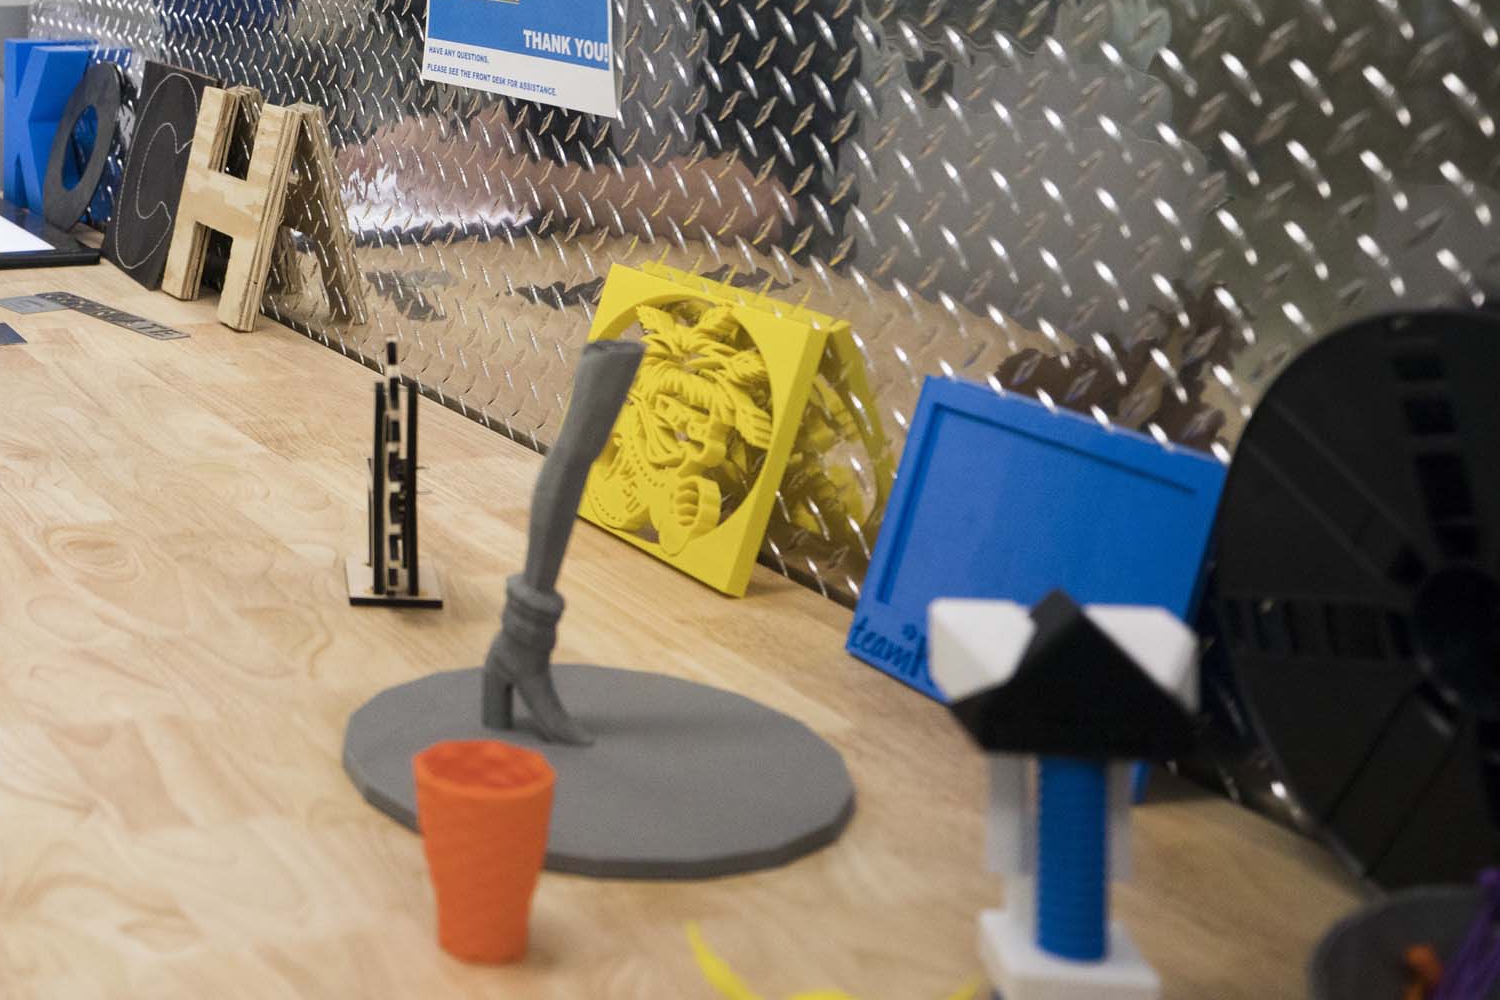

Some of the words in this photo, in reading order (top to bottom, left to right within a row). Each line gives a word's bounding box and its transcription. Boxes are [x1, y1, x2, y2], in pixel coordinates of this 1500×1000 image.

[428, 46, 443, 57] HAVE
[444, 48, 456, 58] ANY
[523, 29, 571, 56] THANK
[574, 38, 610, 63] YOU!
[427, 63, 448, 75] PLEASE
[449, 66, 459, 77] SEE
[460, 69, 471, 79] THE
[472, 71, 491, 83] FRONT
[492, 74, 506, 86] DESK
[507, 77, 518, 88] FOR
